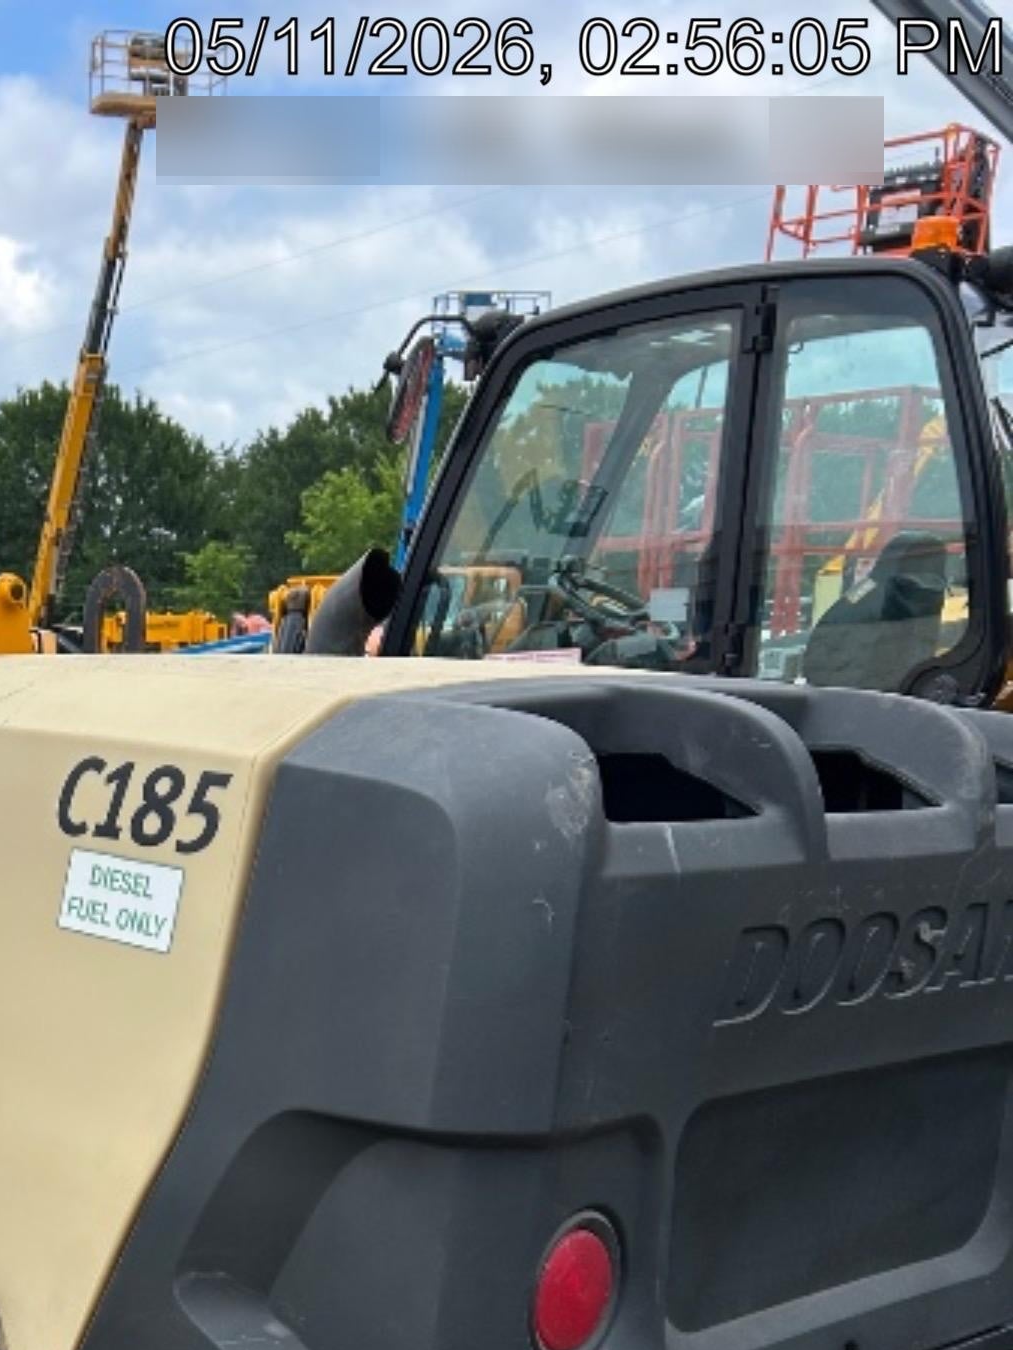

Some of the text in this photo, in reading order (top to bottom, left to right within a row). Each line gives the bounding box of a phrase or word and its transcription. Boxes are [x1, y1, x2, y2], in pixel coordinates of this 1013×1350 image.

[58, 756, 234, 854] C185
[89, 863, 153, 900] DIESEL
[67, 896, 168, 939] FUEL ONLY
[712, 899, 1013, 1028] DOOSA
